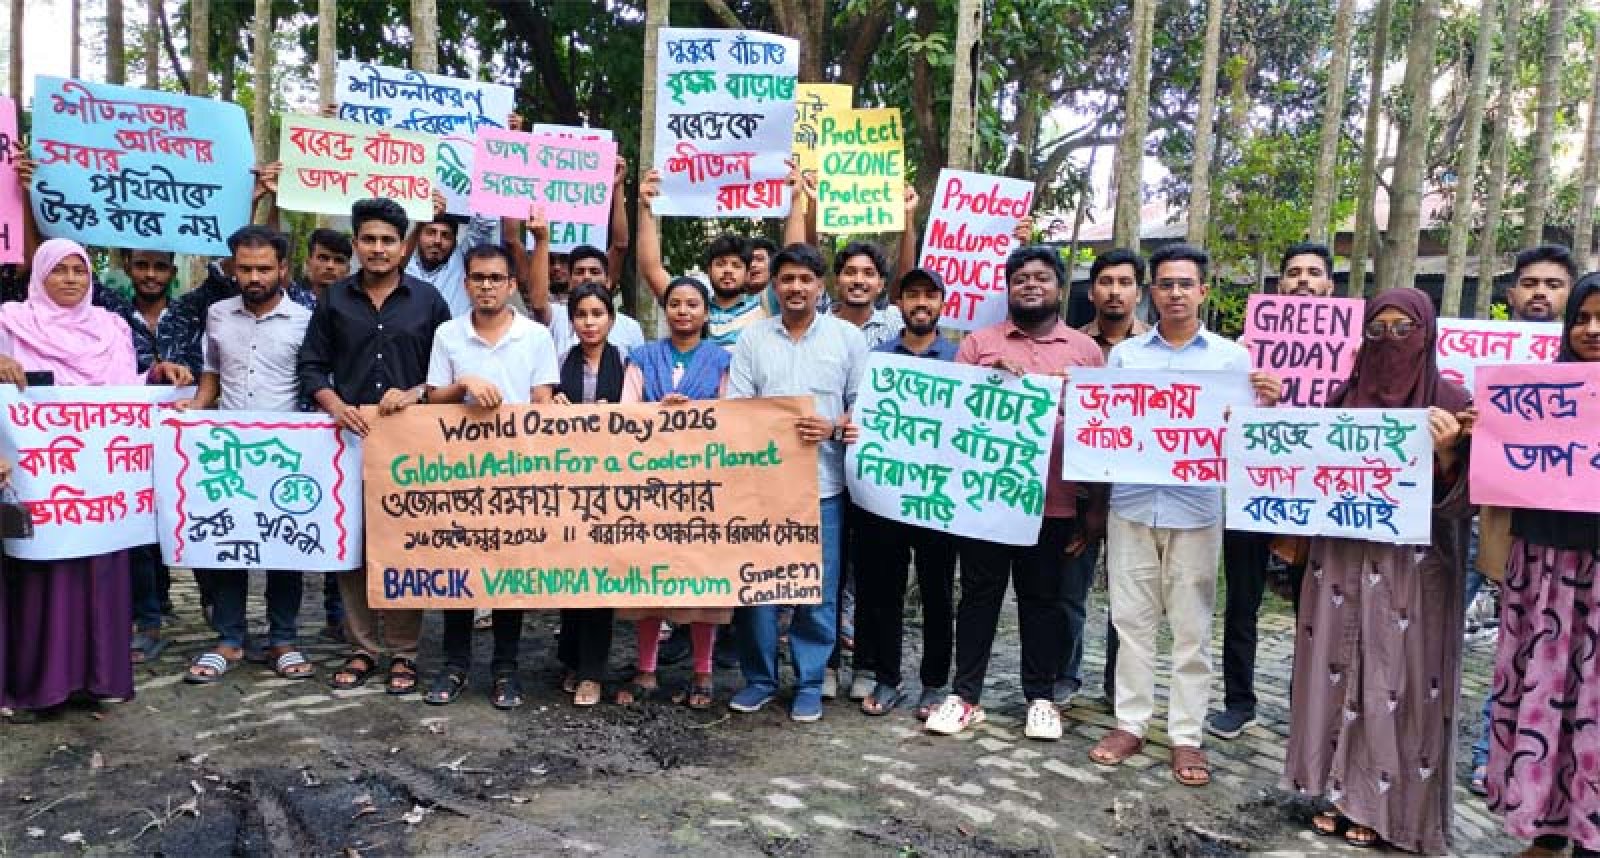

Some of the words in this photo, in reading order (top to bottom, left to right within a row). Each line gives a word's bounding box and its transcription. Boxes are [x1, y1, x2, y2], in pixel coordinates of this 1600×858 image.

[821, 116, 900, 146] Protect
[666, 142, 756, 184] শীতল
[823, 151, 900, 176] OZONE
[819, 180, 891, 204] Protect
[104, 207, 166, 237] করে
[548, 222, 596, 244] EAT
[824, 207, 893, 227] Earth
[1254, 300, 1352, 338] GREEN
[1252, 338, 1345, 373] TODAY
[872, 368, 962, 408] ওজোন
[964, 374, 1056, 436] বাঁচাই
[1075, 384, 1201, 419] জলাশয়
[1488, 382, 1584, 420] বরেন্দ্র
[439, 412, 516, 442] World
[523, 410, 600, 435] Ozone
[608, 411, 653, 442] Day
[658, 408, 717, 432] 2026
[862, 398, 943, 448] জীবন
[952, 422, 1044, 476] বাঁচাই
[1243, 420, 1319, 454] সবুজ
[390, 453, 476, 486] Global
[554, 448, 598, 473] For
[604, 456, 623, 472] a
[704, 440, 782, 469] Planet
[384, 567, 474, 599] BARCIK
[480, 567, 589, 596] VARENDRA
[652, 564, 731, 596] Forum
